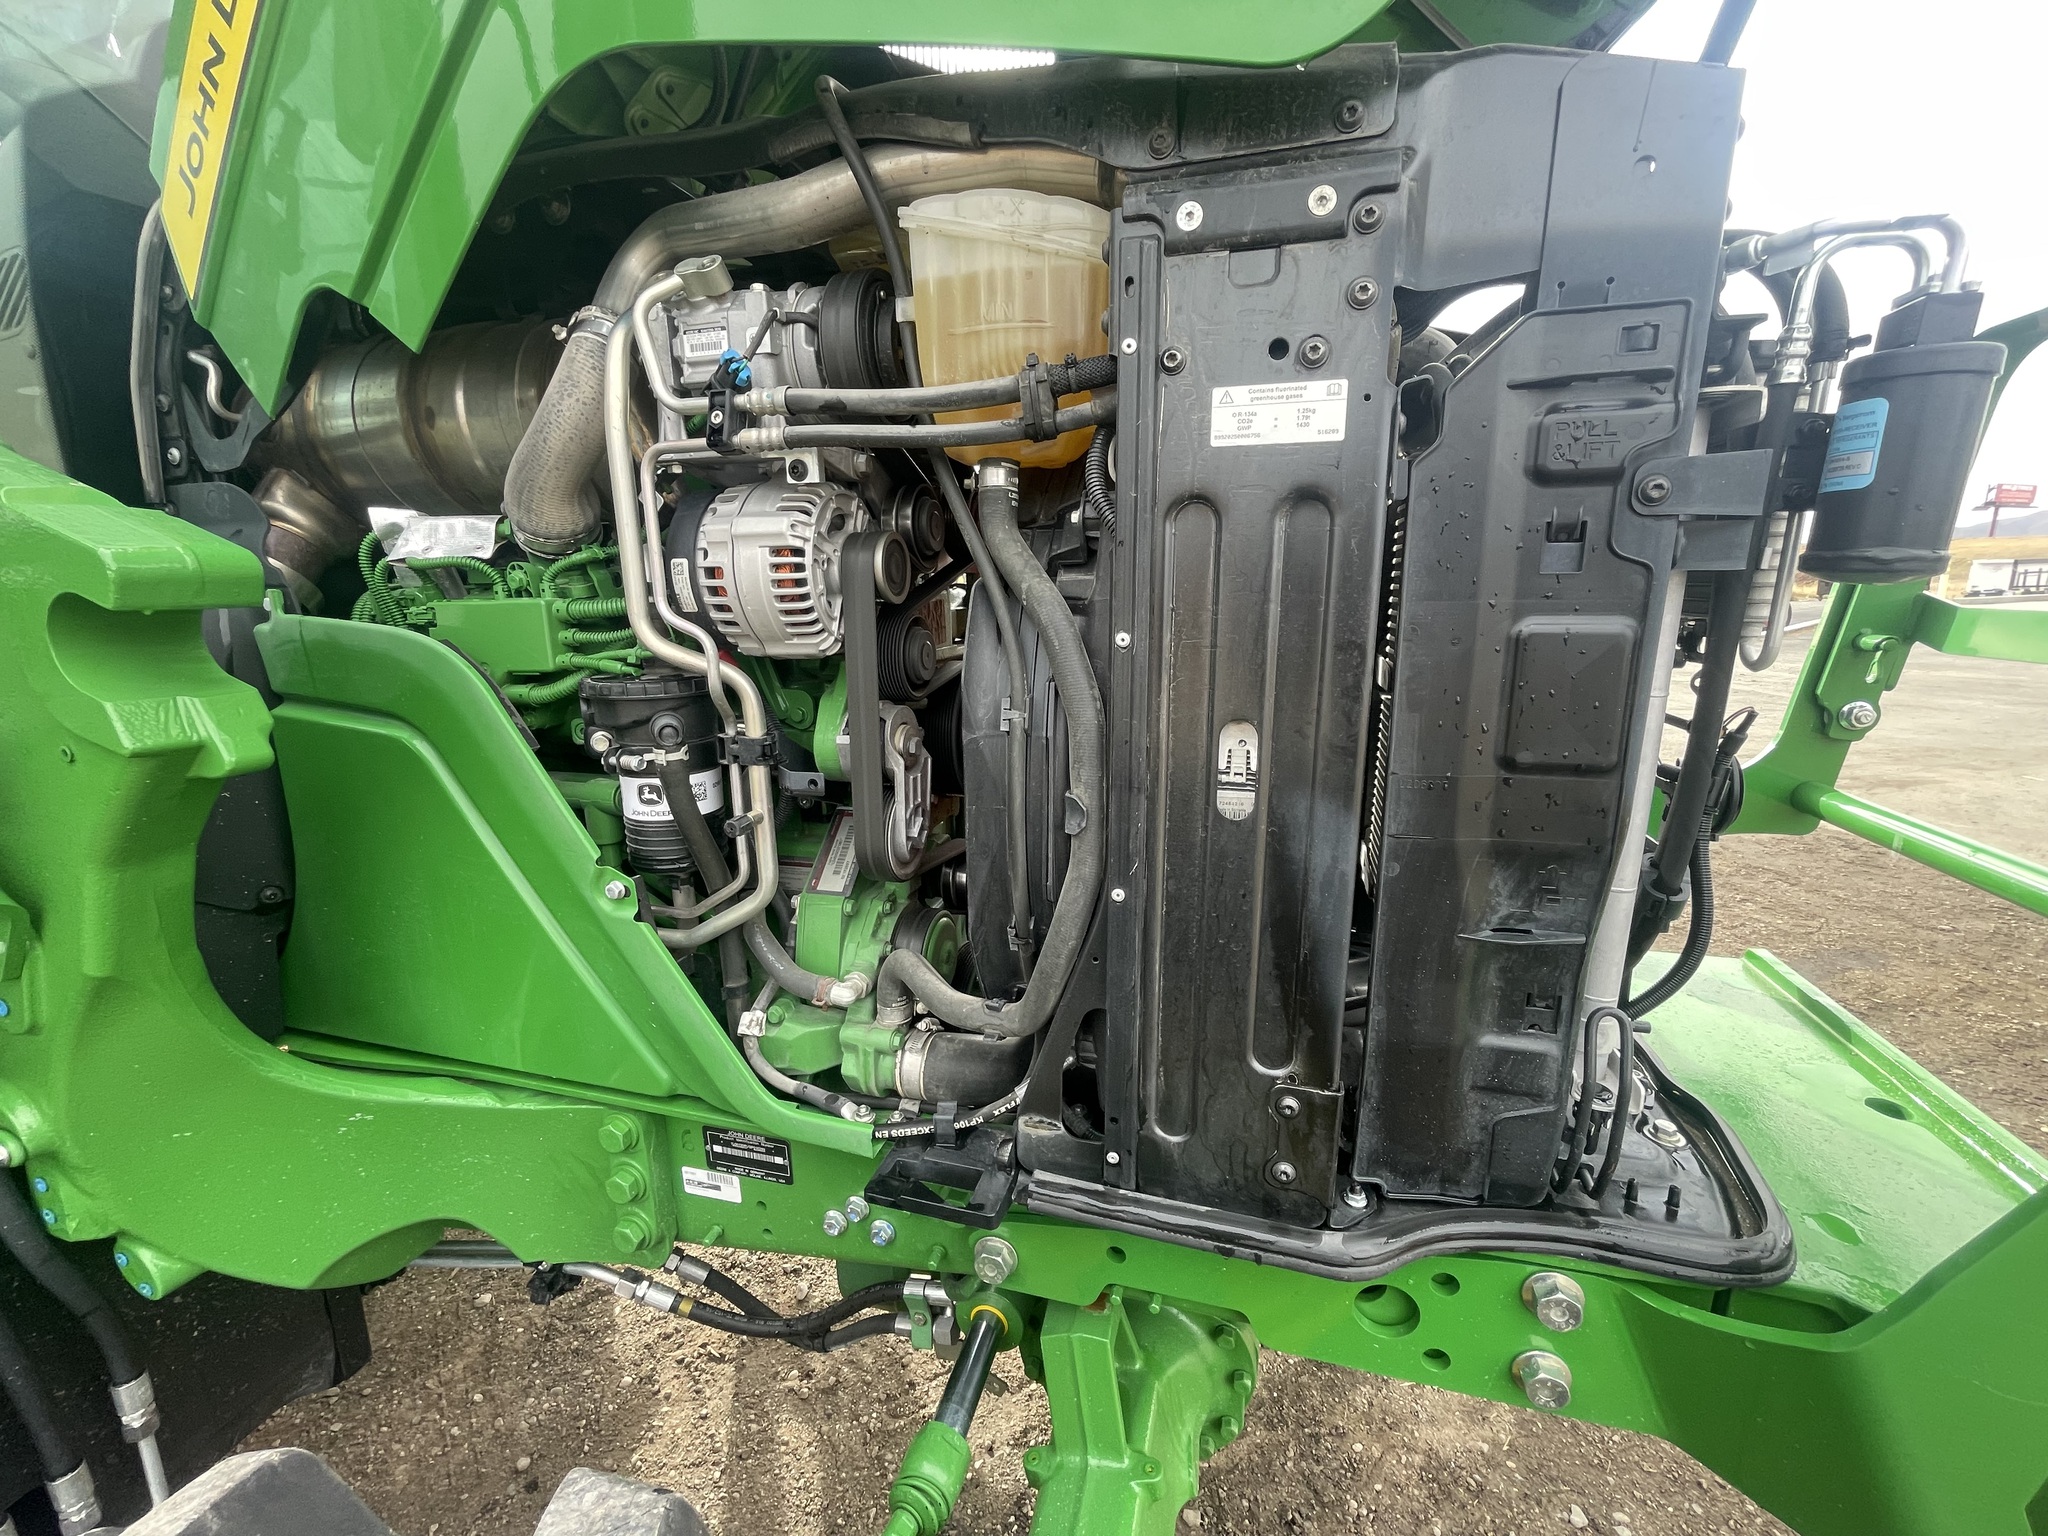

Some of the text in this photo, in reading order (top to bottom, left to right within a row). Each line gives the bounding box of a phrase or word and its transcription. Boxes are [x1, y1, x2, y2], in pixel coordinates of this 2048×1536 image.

[179, 32, 226, 219] JOHN
[1248, 387, 1274, 395] Contains
[1554, 420, 1617, 440] PULL
[631, 808, 649, 817] JOHN
[953, 1115, 984, 1130] KP106
[727, 1130, 766, 1142] JOHN DEERE
[874, 1130, 889, 1139] EN
